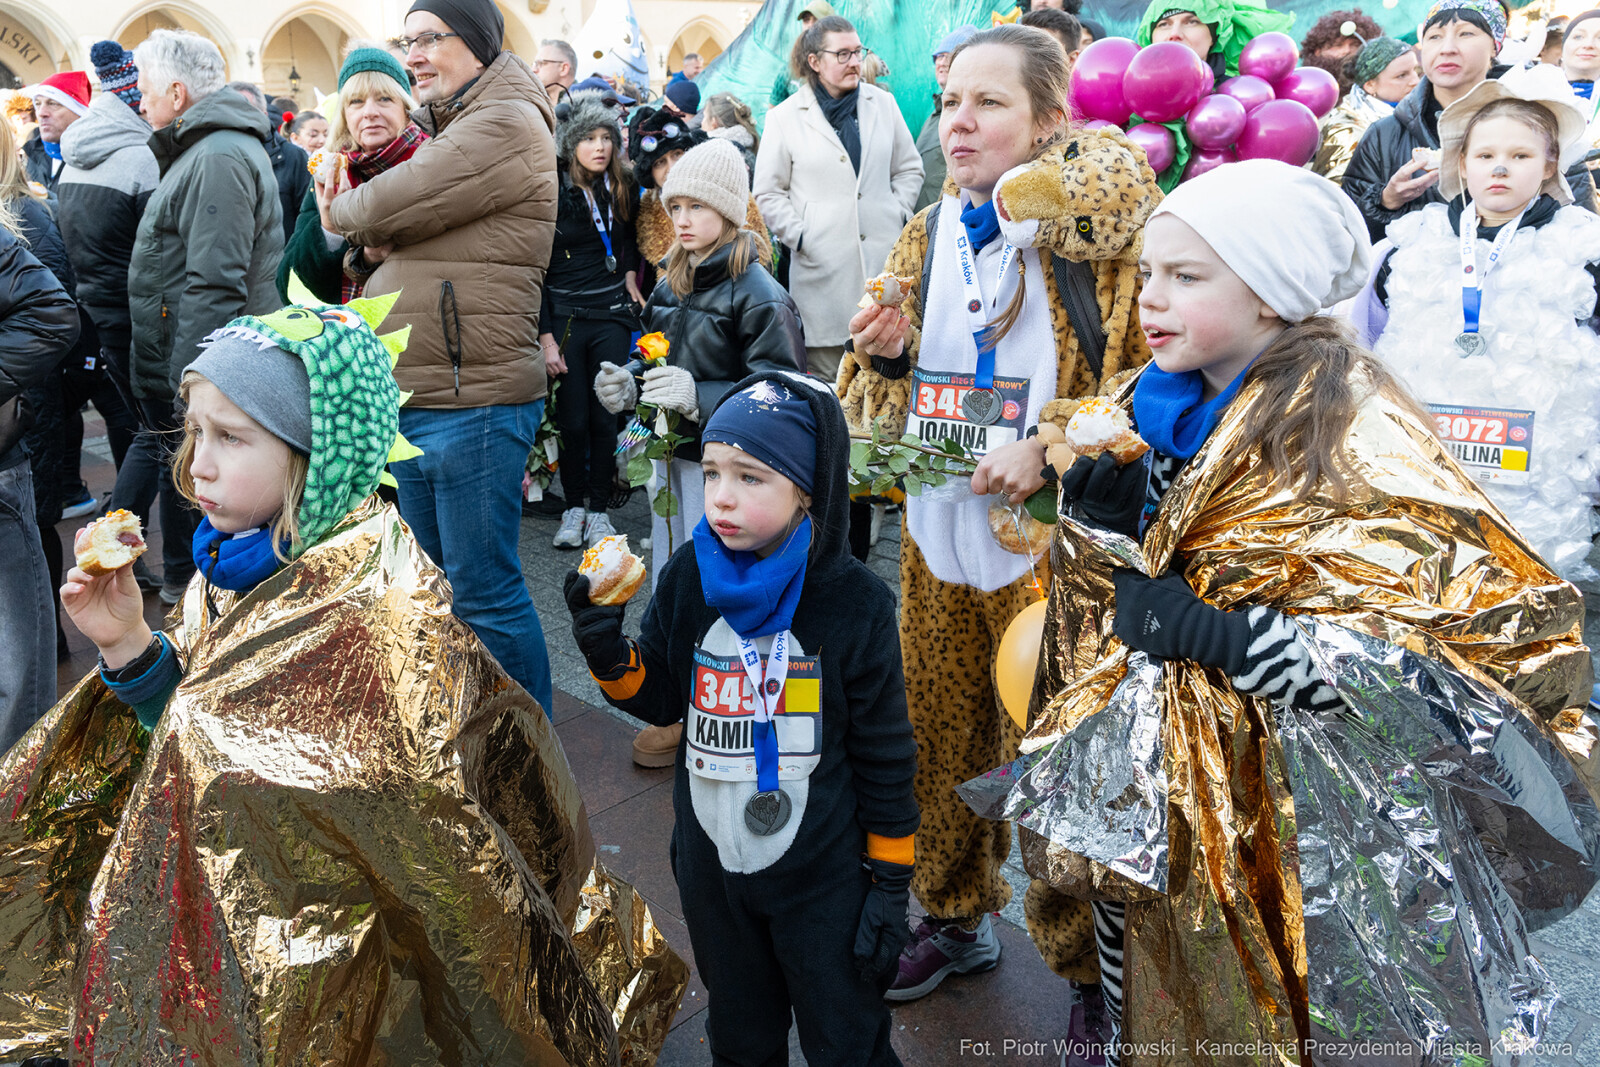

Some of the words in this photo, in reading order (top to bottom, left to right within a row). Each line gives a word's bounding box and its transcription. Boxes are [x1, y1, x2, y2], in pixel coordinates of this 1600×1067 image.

[960, 250, 973, 285] Kraków
[951, 376, 968, 385] BIEG
[970, 378, 1023, 390] SSTROWY
[919, 386, 972, 418] 345
[1463, 408, 1479, 416] BIEG
[918, 420, 987, 451] JOANNA
[1436, 415, 1503, 443] 3072
[700, 672, 777, 712] 345
[695, 715, 779, 750] KAMI
